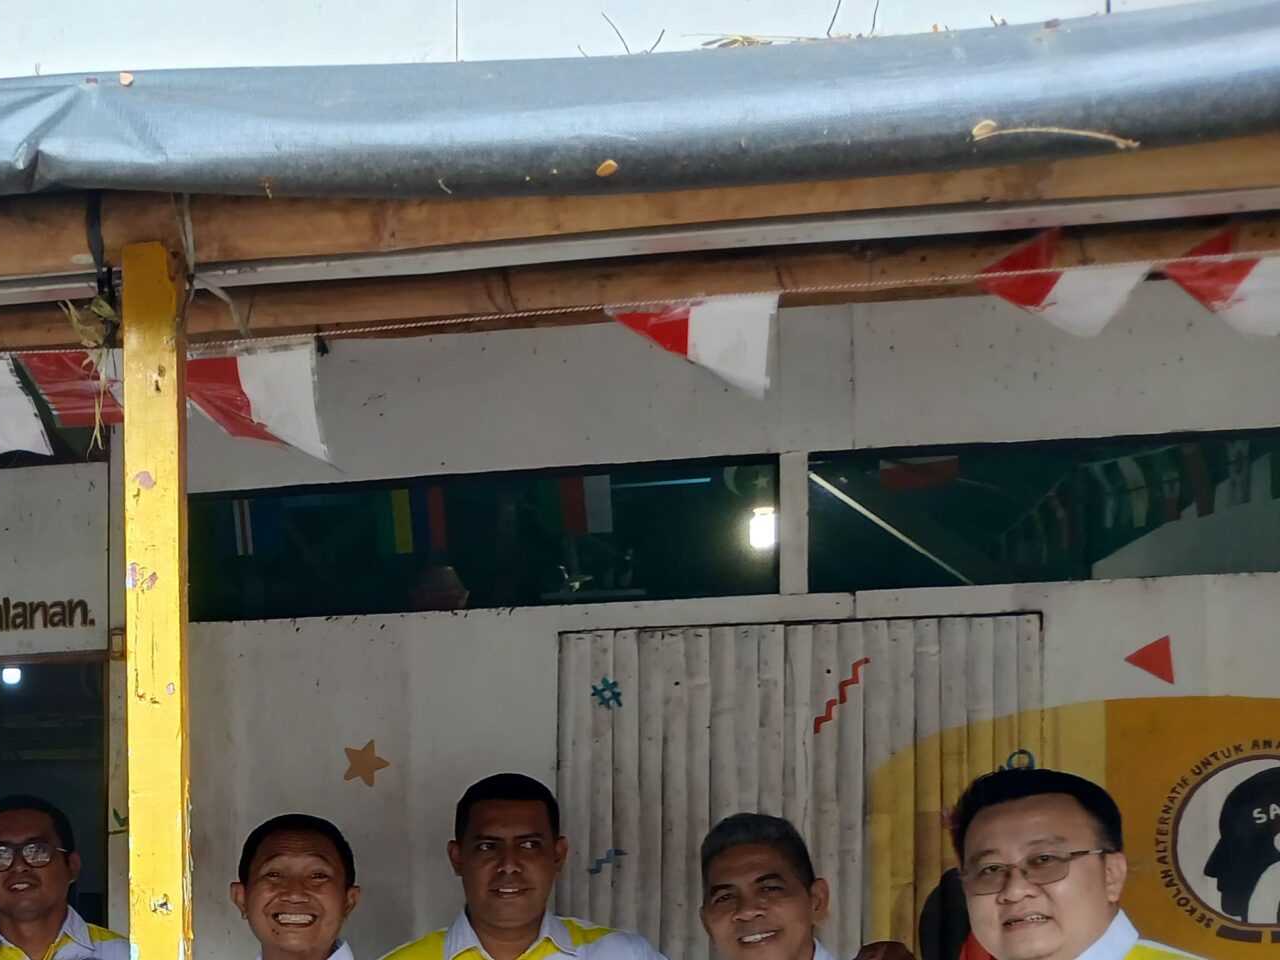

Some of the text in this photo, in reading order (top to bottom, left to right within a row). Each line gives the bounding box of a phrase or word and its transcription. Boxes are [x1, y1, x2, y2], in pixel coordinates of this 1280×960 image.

[1190, 743, 1244, 776] UNTUK
[1155, 775, 1190, 866] ALTERNATIF
[1160, 869, 1214, 929] SEKOLAH
